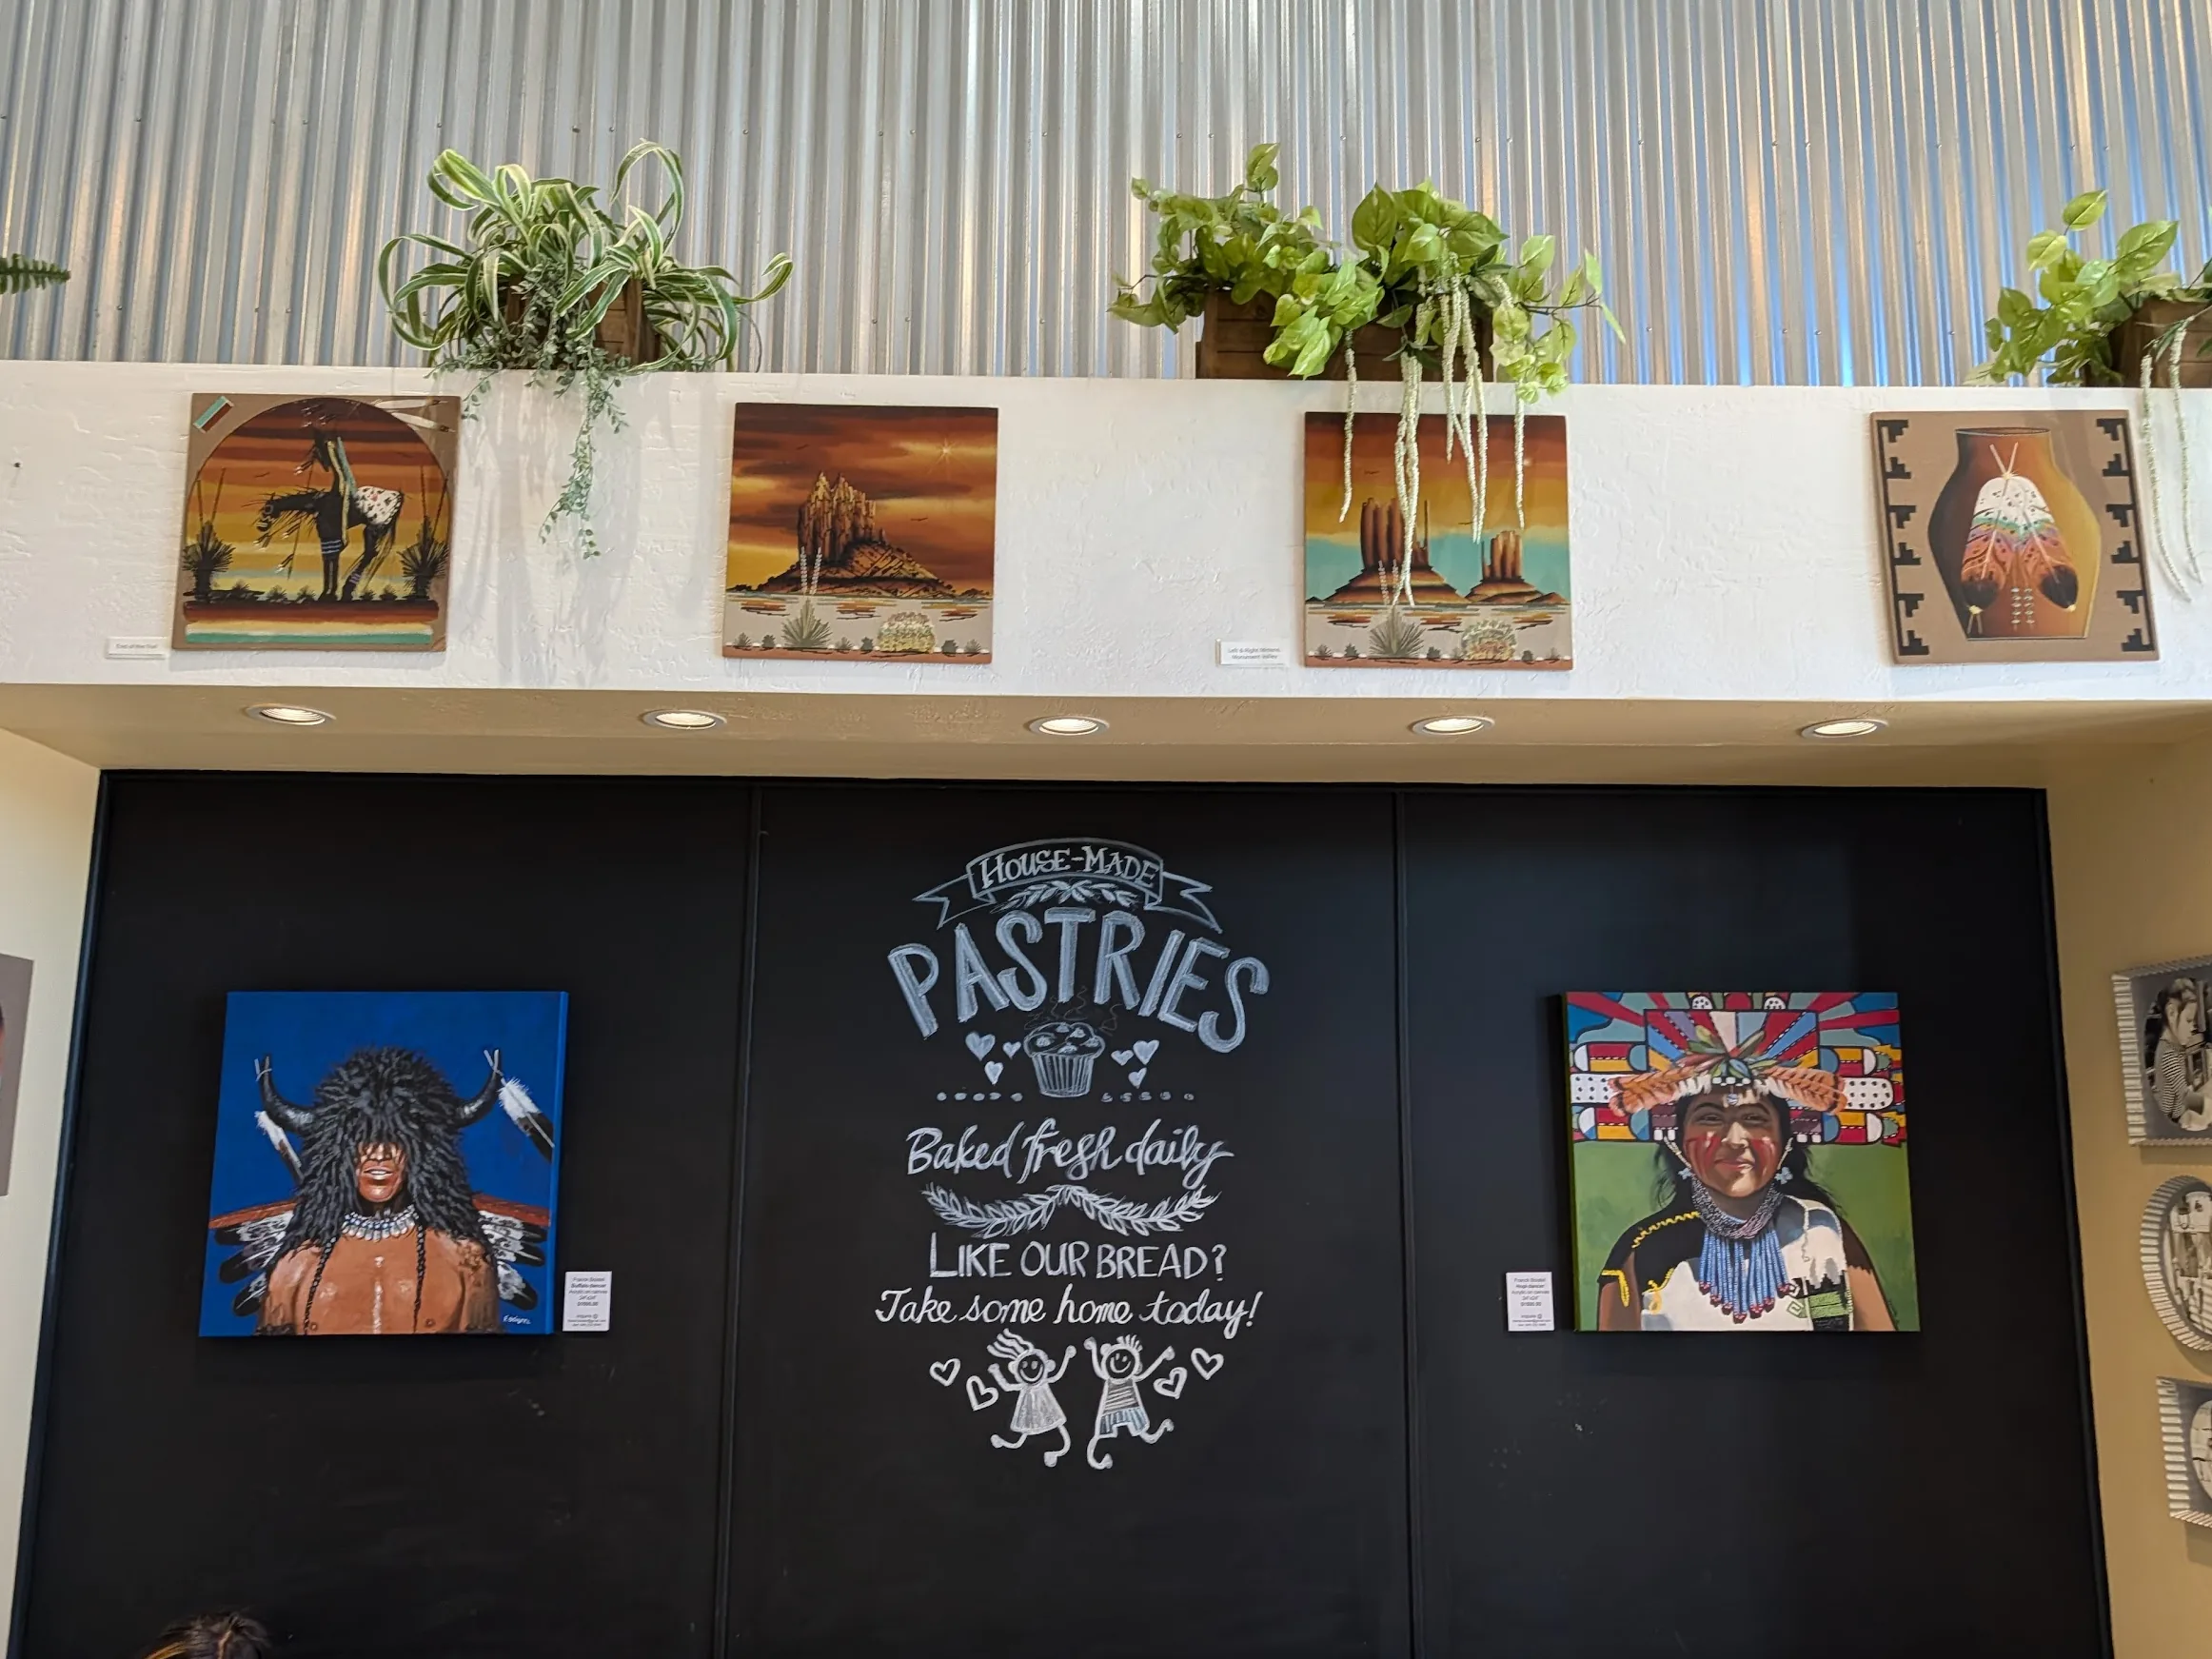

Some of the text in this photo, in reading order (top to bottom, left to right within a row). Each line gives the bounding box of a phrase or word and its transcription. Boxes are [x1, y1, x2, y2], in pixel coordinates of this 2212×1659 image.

[887, 907, 1270, 1054] PASTRIES
[906, 1117, 1234, 1190] Baked fresh daily
[929, 1232, 1227, 1281] LIKE OUR BREAD?
[875, 1283, 1263, 1339] Take some home today!
